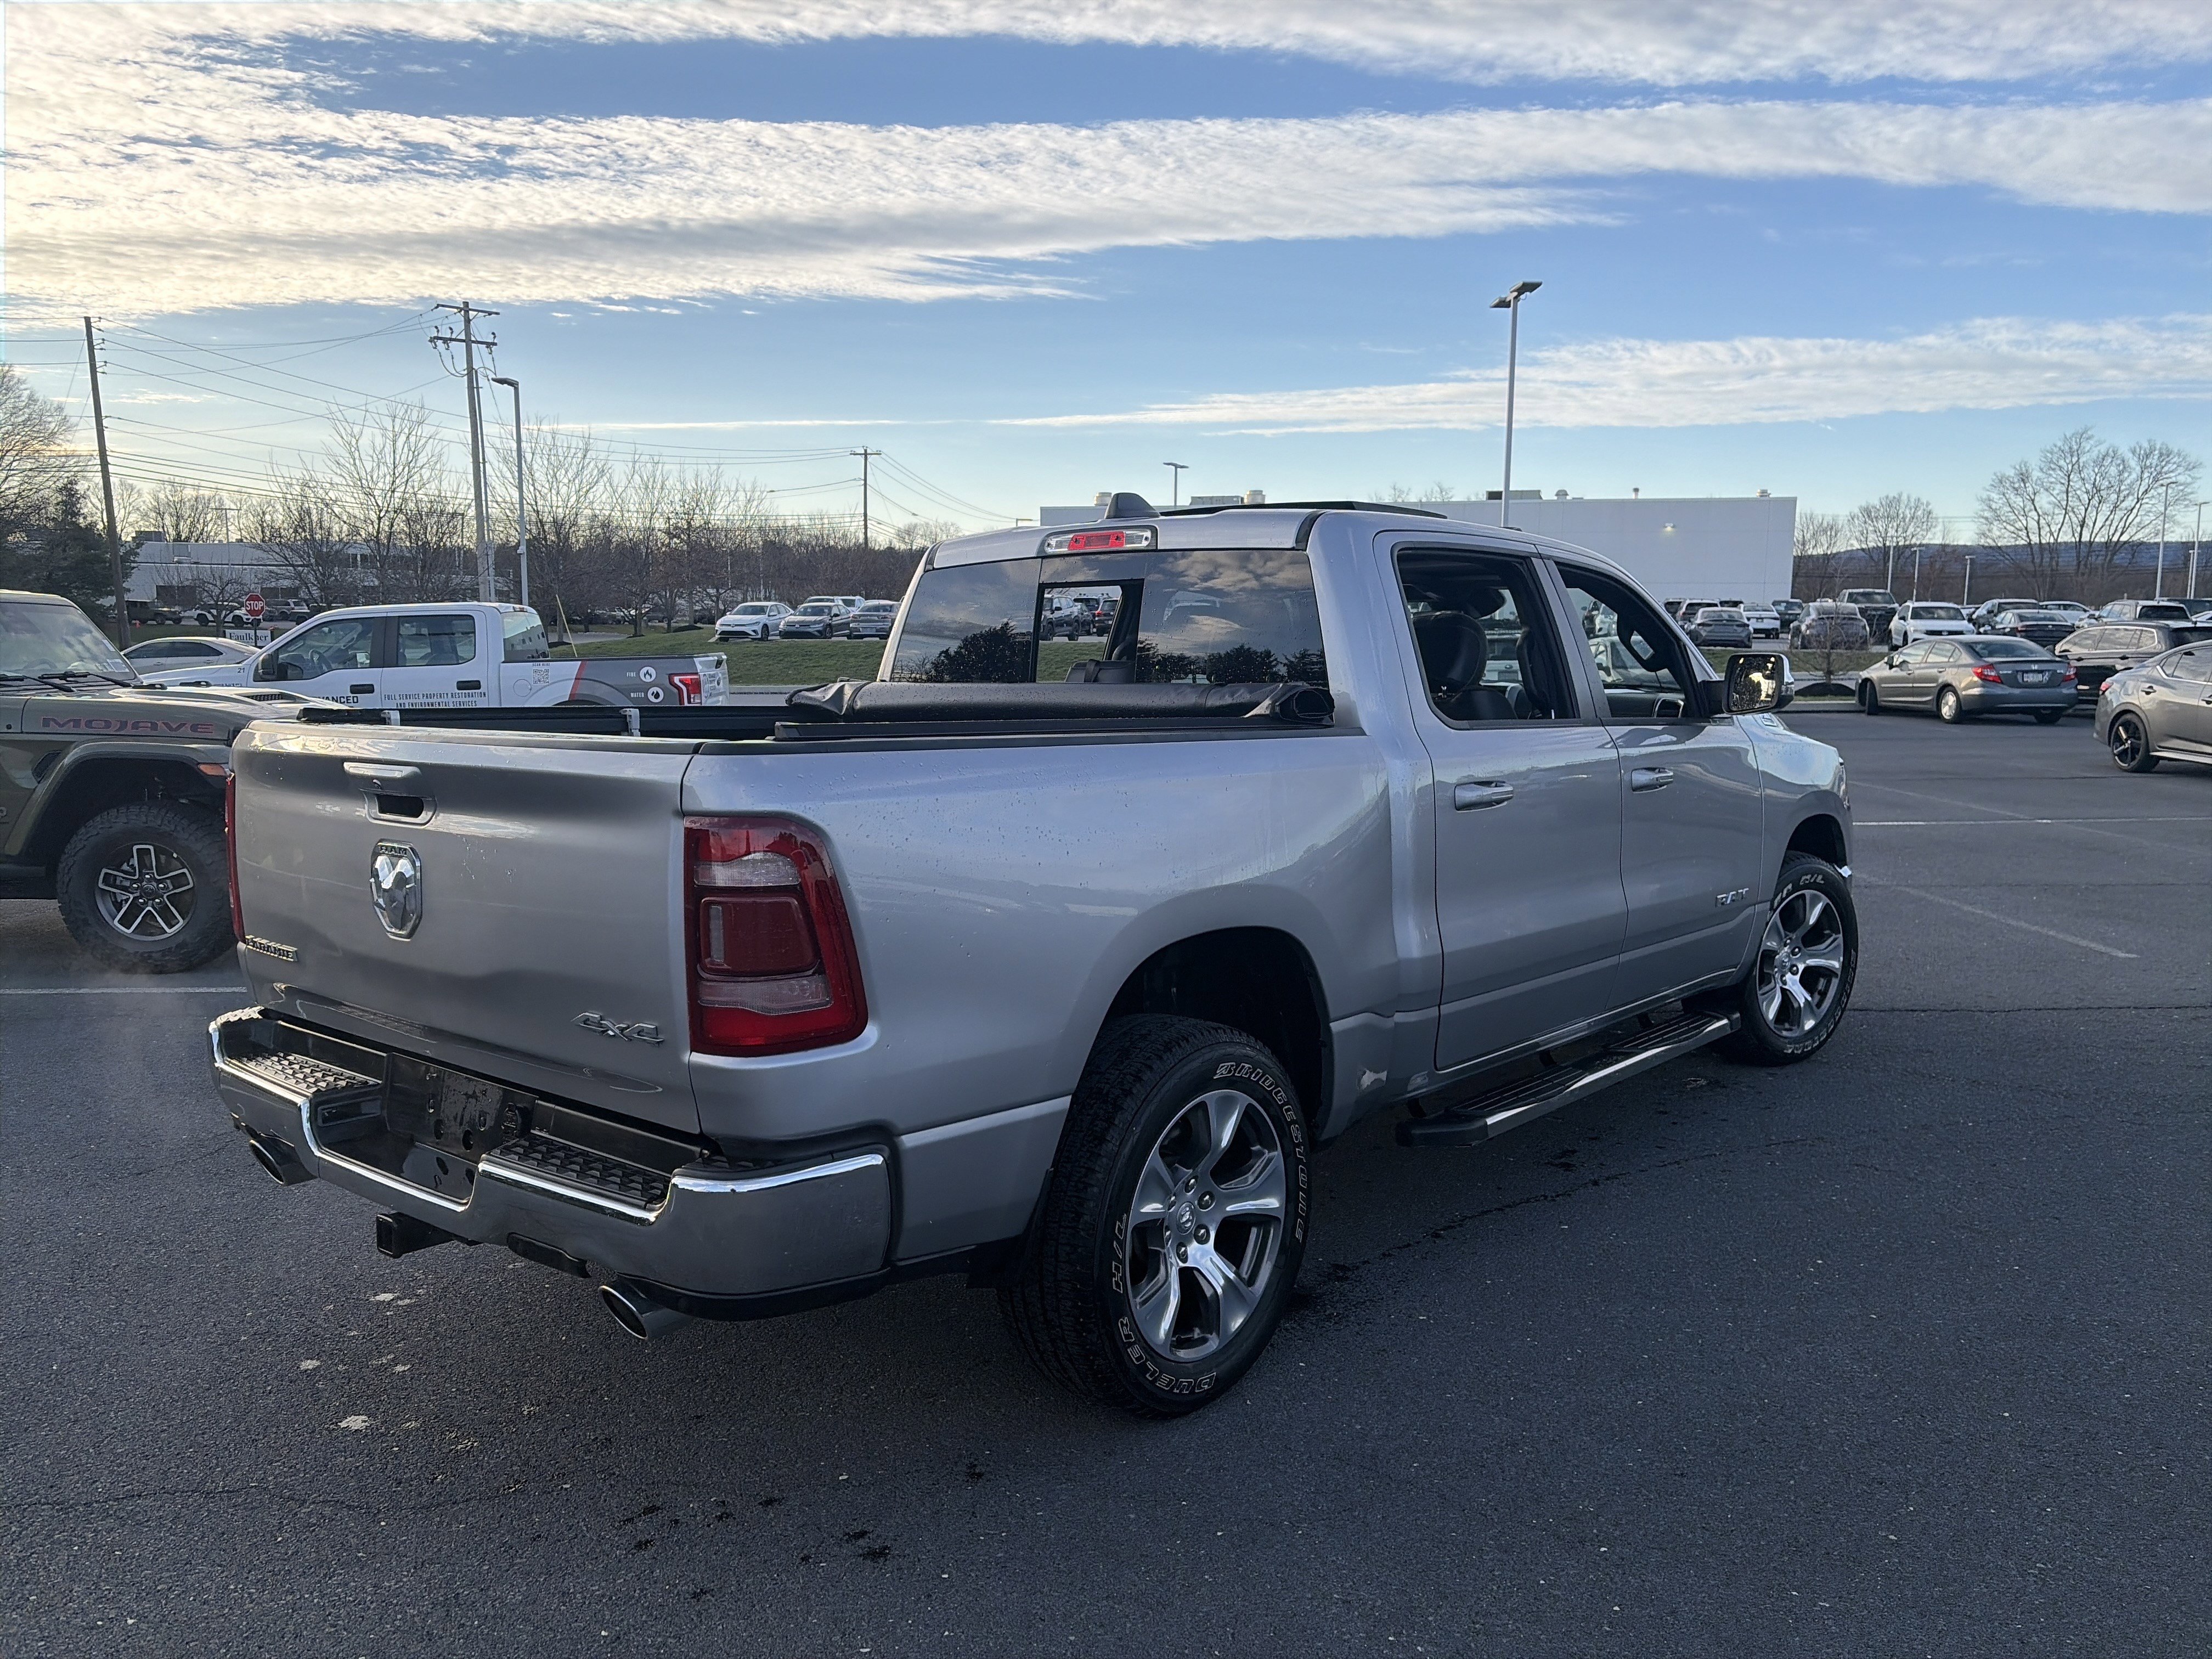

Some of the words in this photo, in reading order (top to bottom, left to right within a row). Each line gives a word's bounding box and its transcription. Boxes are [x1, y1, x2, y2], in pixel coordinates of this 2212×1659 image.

[246, 601, 264, 611] STOP
[229, 632, 269, 641] Faulkner
[41, 716, 214, 735] MOJAVE
[379, 846, 408, 856] RAM
[1213, 1062, 1307, 1244] BRIDGESTONE
[1112, 1213, 1127, 1294] H/L
[1118, 1316, 1217, 1394] DUELER
